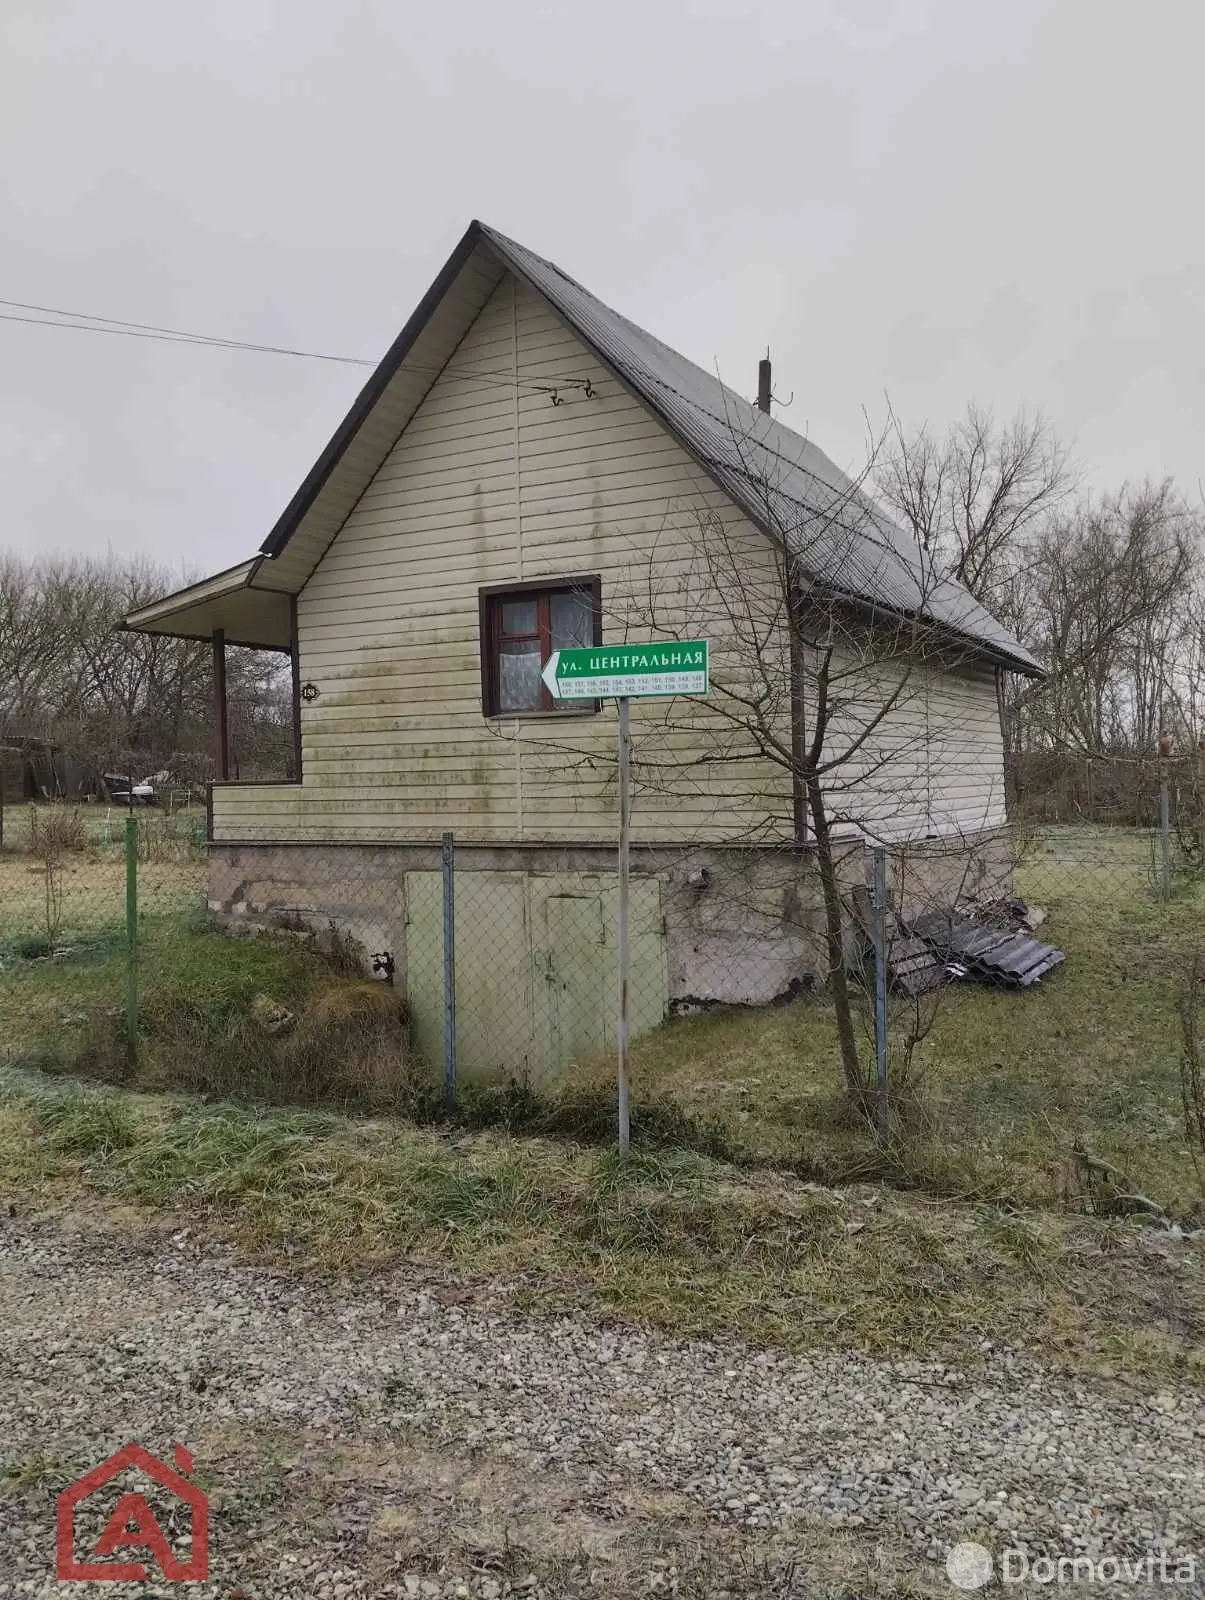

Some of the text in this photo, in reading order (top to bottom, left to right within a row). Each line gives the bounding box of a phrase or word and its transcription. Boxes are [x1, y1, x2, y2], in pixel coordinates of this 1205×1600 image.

[562, 652, 703, 674] ул. ЦЕНТРАЛЬНАЯ
[304, 689, 315, 697] 158
